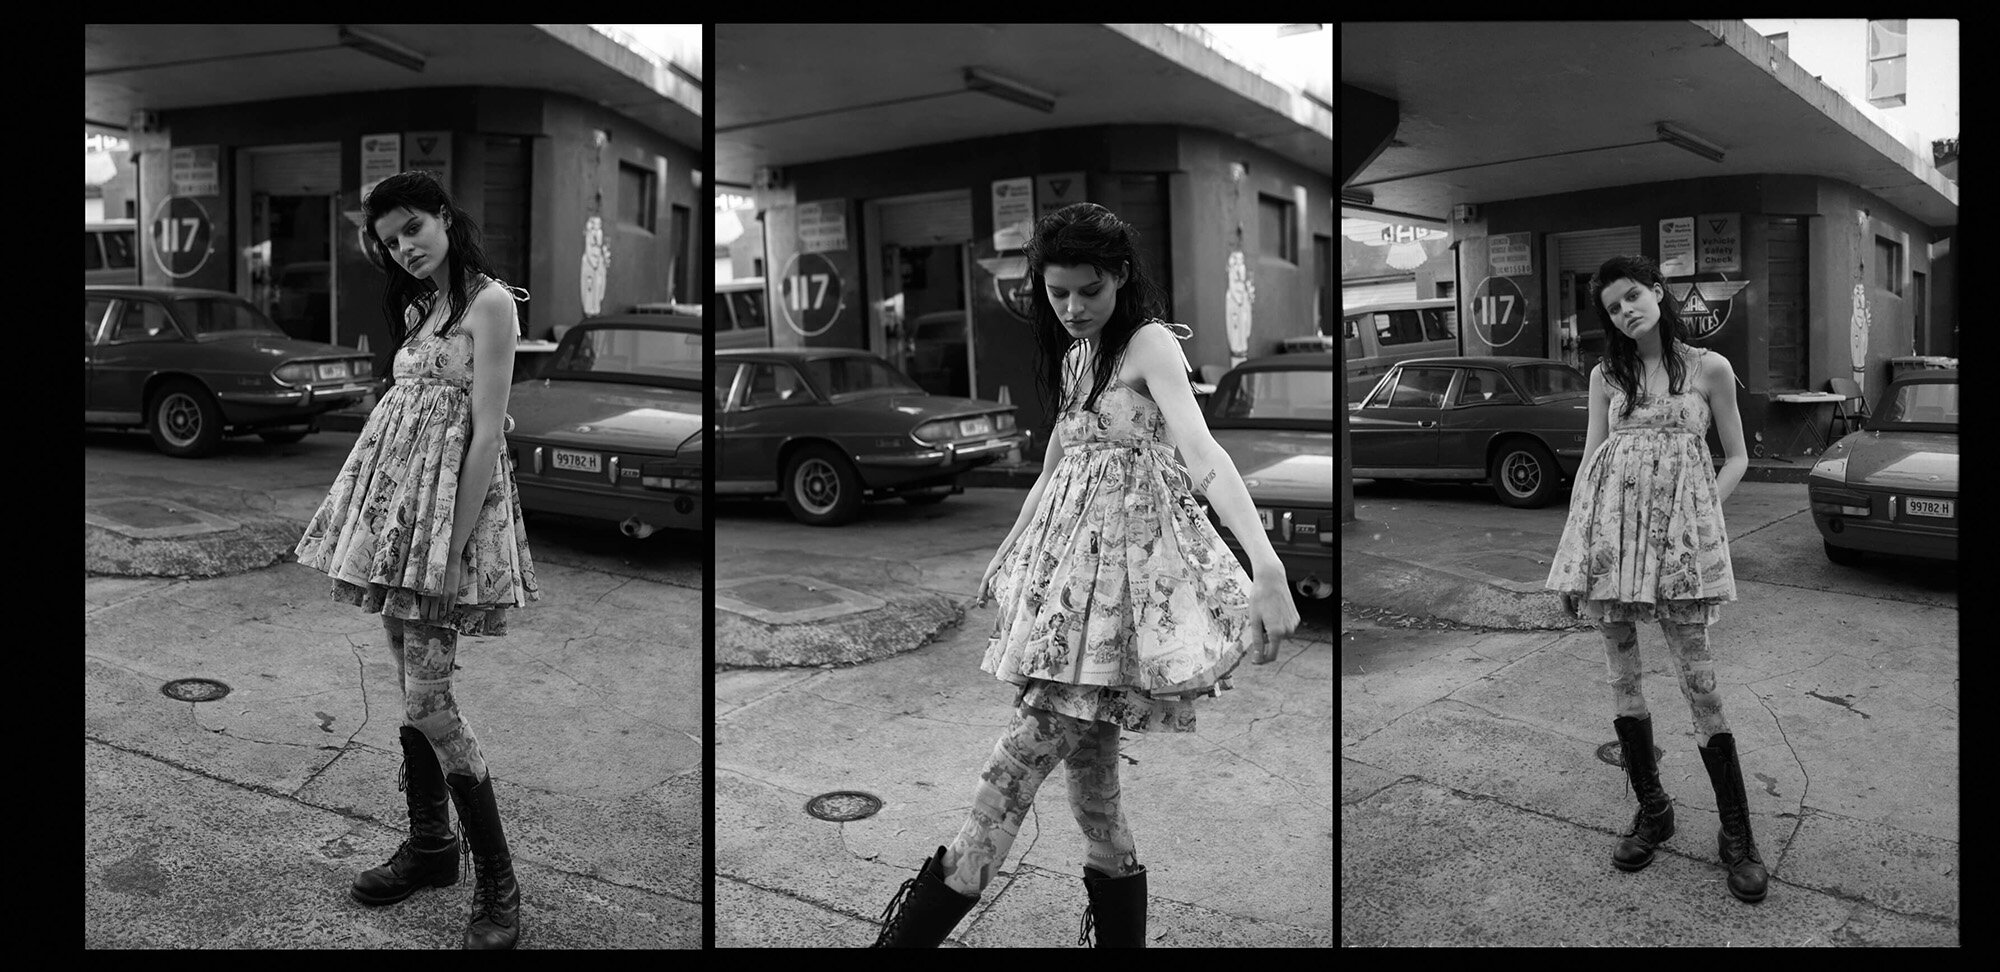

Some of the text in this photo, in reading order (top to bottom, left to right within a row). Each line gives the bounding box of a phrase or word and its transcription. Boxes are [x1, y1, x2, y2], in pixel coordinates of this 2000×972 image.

[162, 218, 200, 252] 117
[790, 274, 829, 311] 117
[1481, 295, 1515, 325] 117
[557, 453, 597, 467] 99782 H
[1910, 501, 1949, 514] 99782 H
